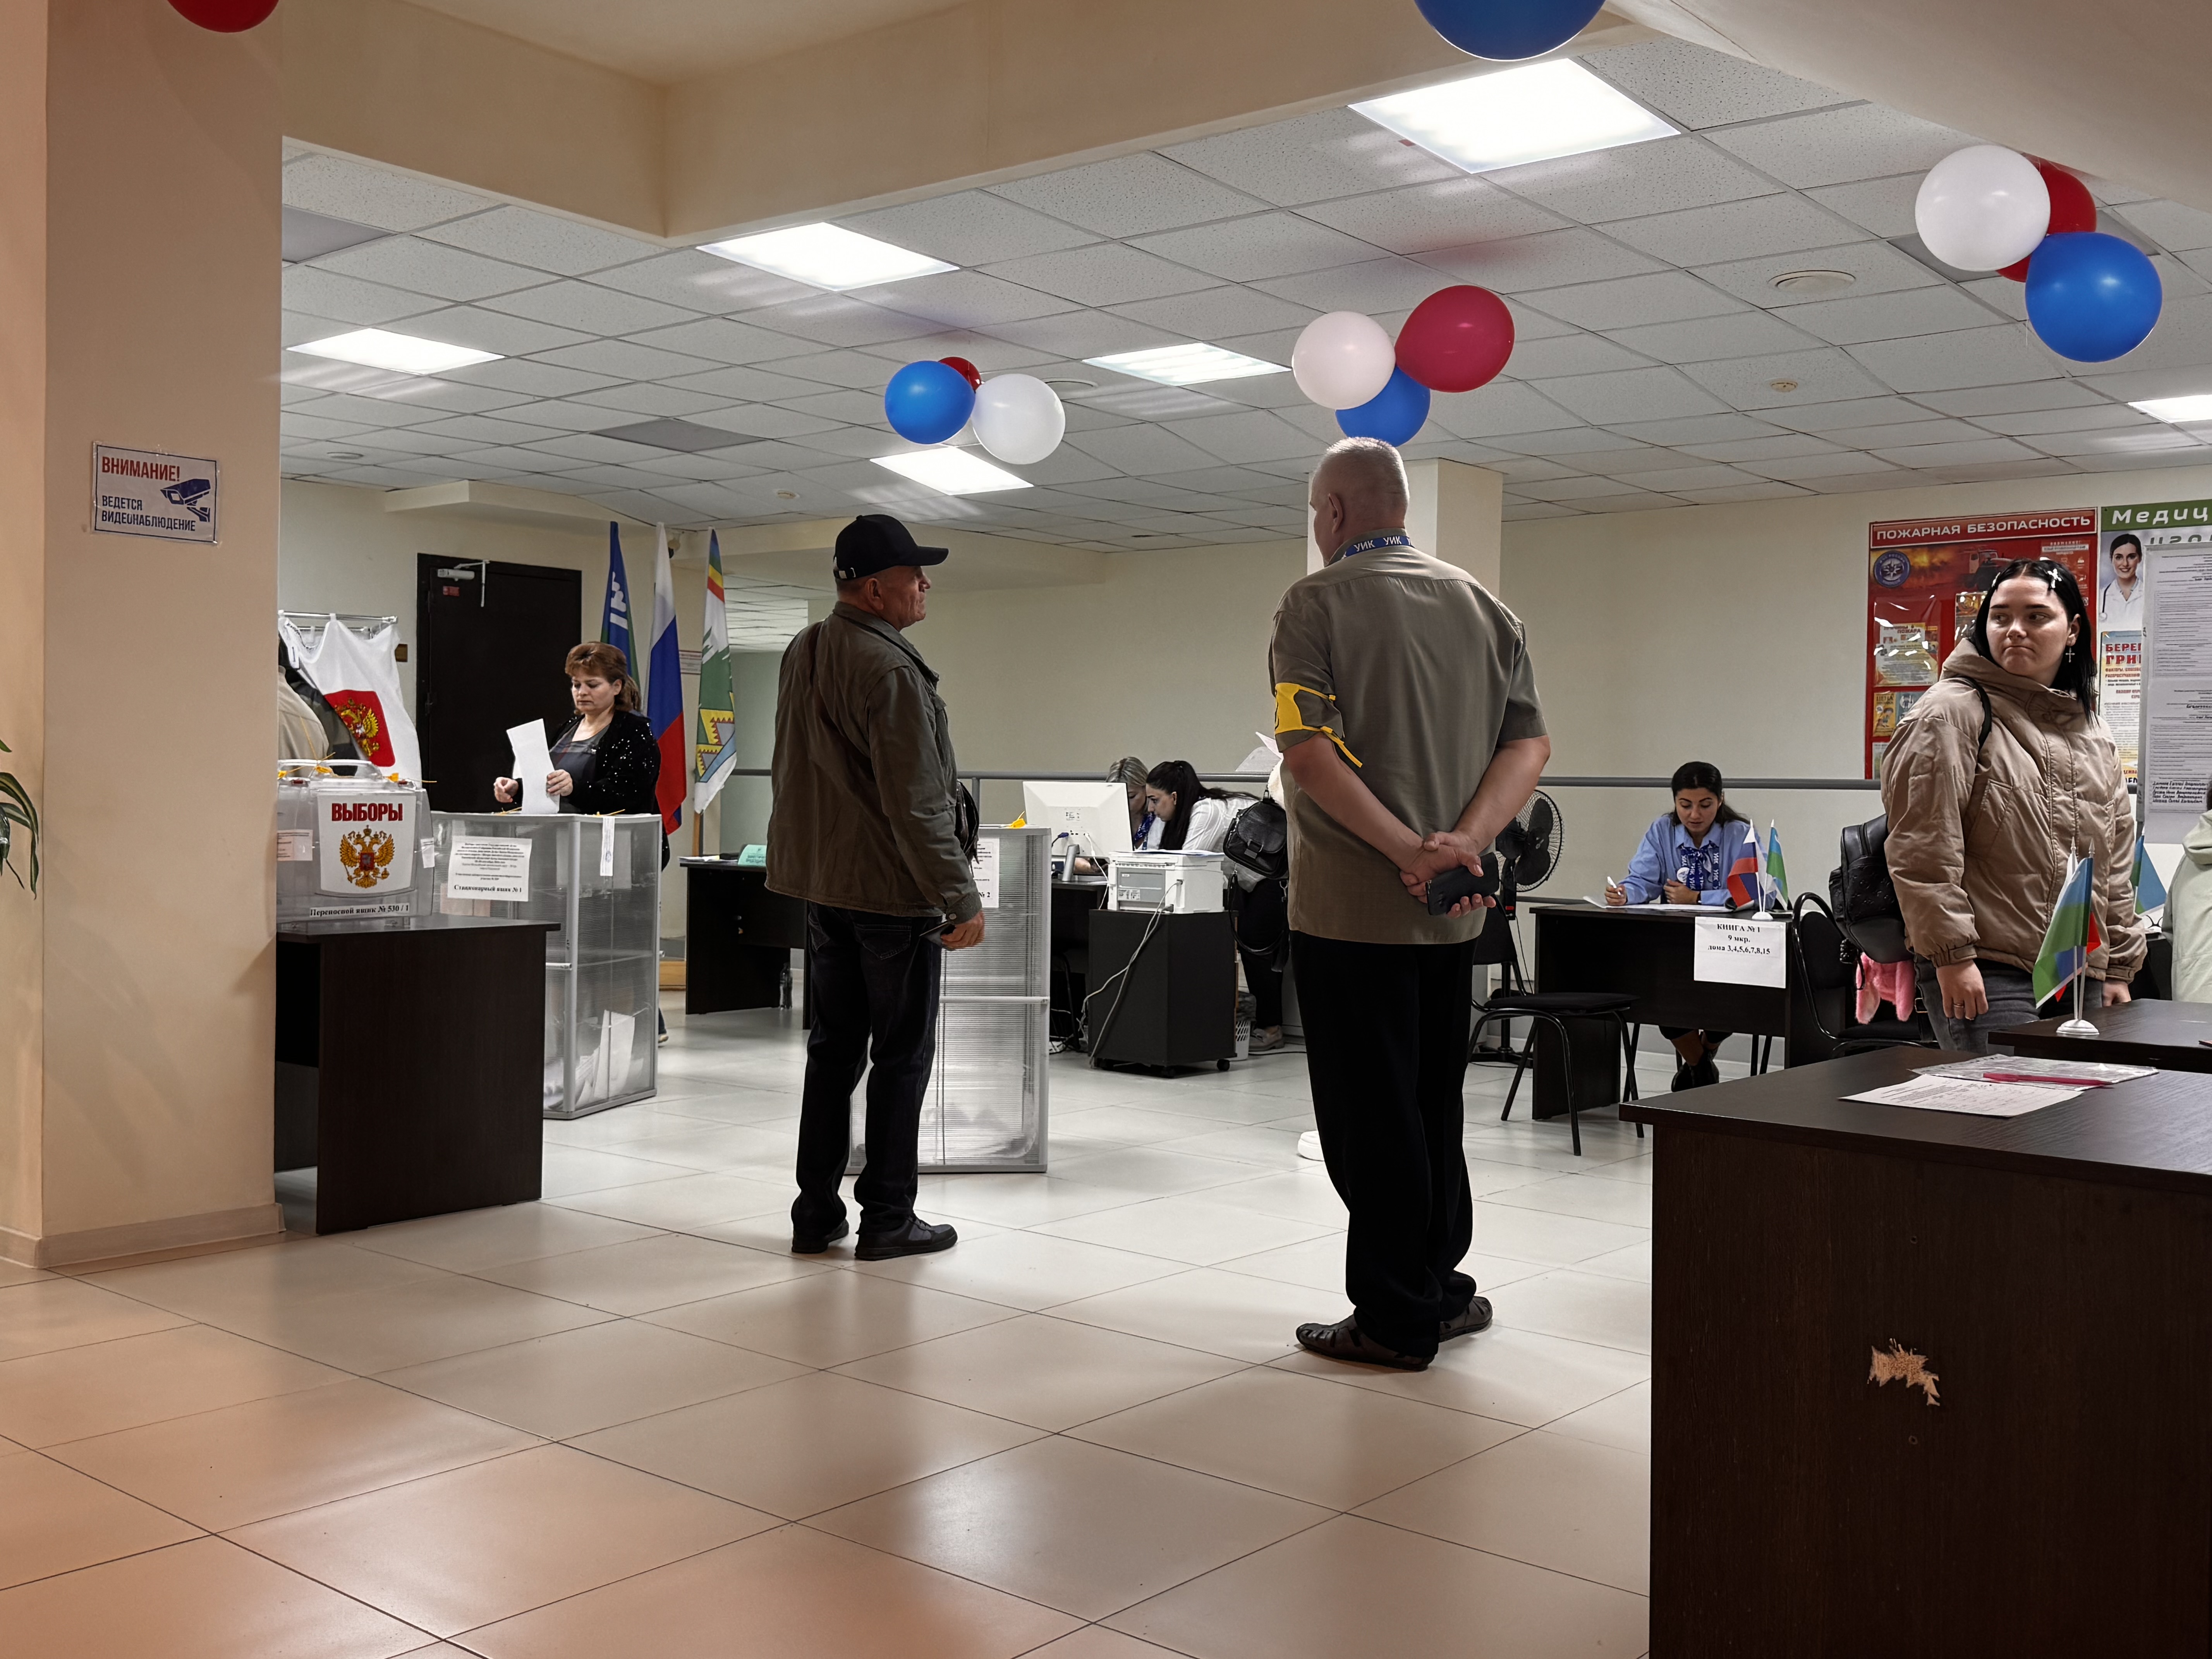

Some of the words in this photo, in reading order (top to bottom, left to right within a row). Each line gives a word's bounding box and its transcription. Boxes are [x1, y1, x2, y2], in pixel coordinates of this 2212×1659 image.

[102, 457, 180, 481] ВНИМАНИЕ!
[102, 495, 143, 510] ВЕДЕТСЯ
[101, 510, 196, 531] ВИДЕОНАБЛЮДЕНИЕ
[2112, 507, 2208, 525] Медиц
[1877, 525, 1960, 540] ПОЖАРНАЯ
[1967, 516, 2090, 533] БЕЗОПАСНОСТЬ
[1354, 540, 1375, 552] УИК
[1383, 536, 1402, 545] УИК
[331, 803, 403, 821] ВЫБОРЫ
[310, 908, 354, 917] Переносной
[1717, 924, 1745, 932] КНИГА
[1728, 945, 1771, 955] 3,4,5,6,7,8,15
